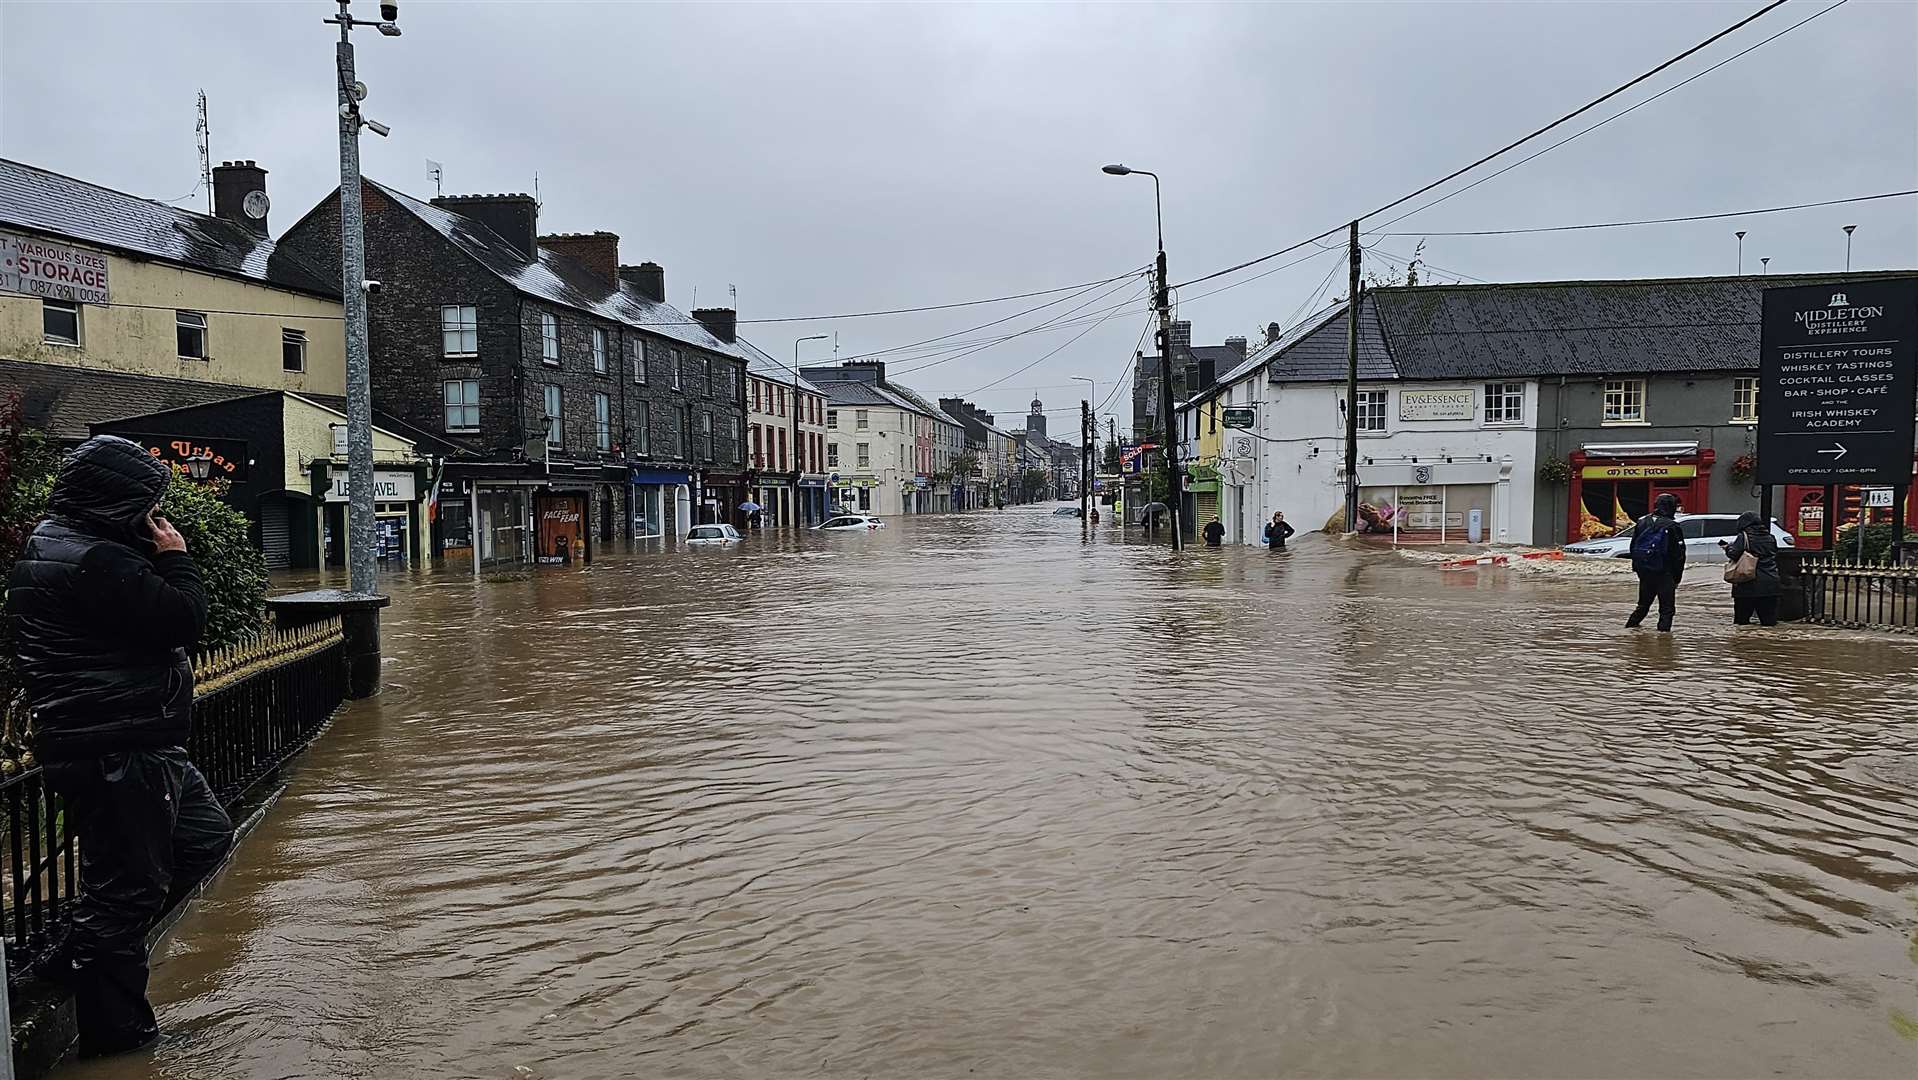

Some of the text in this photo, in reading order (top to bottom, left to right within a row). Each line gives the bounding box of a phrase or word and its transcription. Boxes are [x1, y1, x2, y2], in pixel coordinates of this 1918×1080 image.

[18, 242, 71, 263] VARIOUS
[75, 254, 105, 270] SIZES
[19, 256, 106, 289] STORAGE
[30, 278, 52, 294] 087
[56, 284, 75, 299] 991
[80, 288, 106, 304] 0054
[1794, 306, 1884, 328] MIDLETON
[1808, 326, 1868, 335] EXPERIENCE
[1810, 320, 1866, 329] DISTILLERY
[1783, 347, 1893, 360] DISTILLERY TOURS
[1781, 360, 1894, 372] WHISKEY TASTINGS
[1779, 373, 1895, 385] COCKTAIL CLASSES
[1784, 385, 1888, 397] BAR SHOP CAFÉ
[1791, 408, 1879, 418] IRISH WHISKEY
[1806, 419, 1862, 427] ACADEMY
[170, 440, 236, 473] Urban
[1123, 446, 1143, 461] SOLD
[374, 482, 399, 497] AVEL
[543, 510, 562, 519] FACE
[560, 513, 579, 523] FEAR
